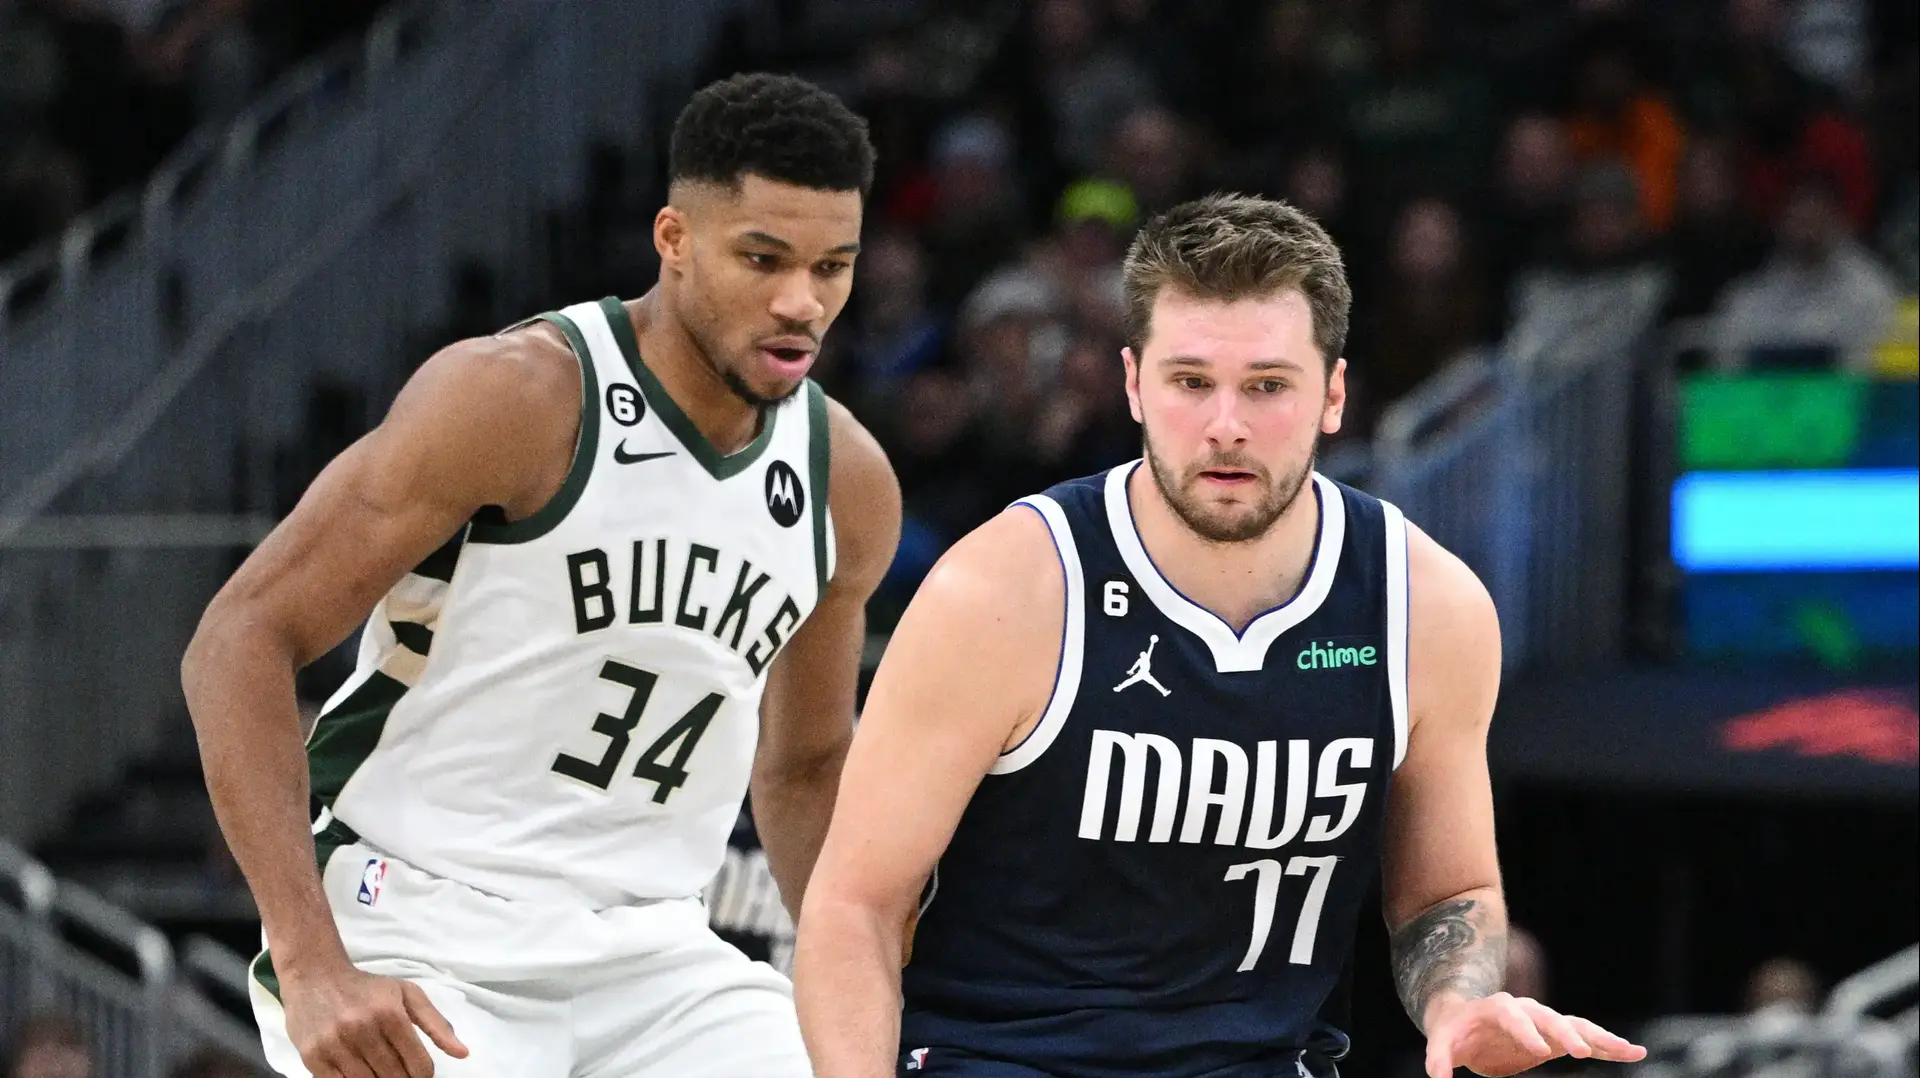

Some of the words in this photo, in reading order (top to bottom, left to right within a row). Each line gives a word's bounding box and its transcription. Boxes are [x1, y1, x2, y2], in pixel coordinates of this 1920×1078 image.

[612, 390, 636, 422] 6
[566, 537, 801, 679] BUCKS
[1103, 580, 1130, 617] 6
[1296, 640, 1377, 670] chime
[551, 658, 727, 806] 34
[1078, 729, 1374, 850] MAVS
[1223, 855, 1339, 973] 77
